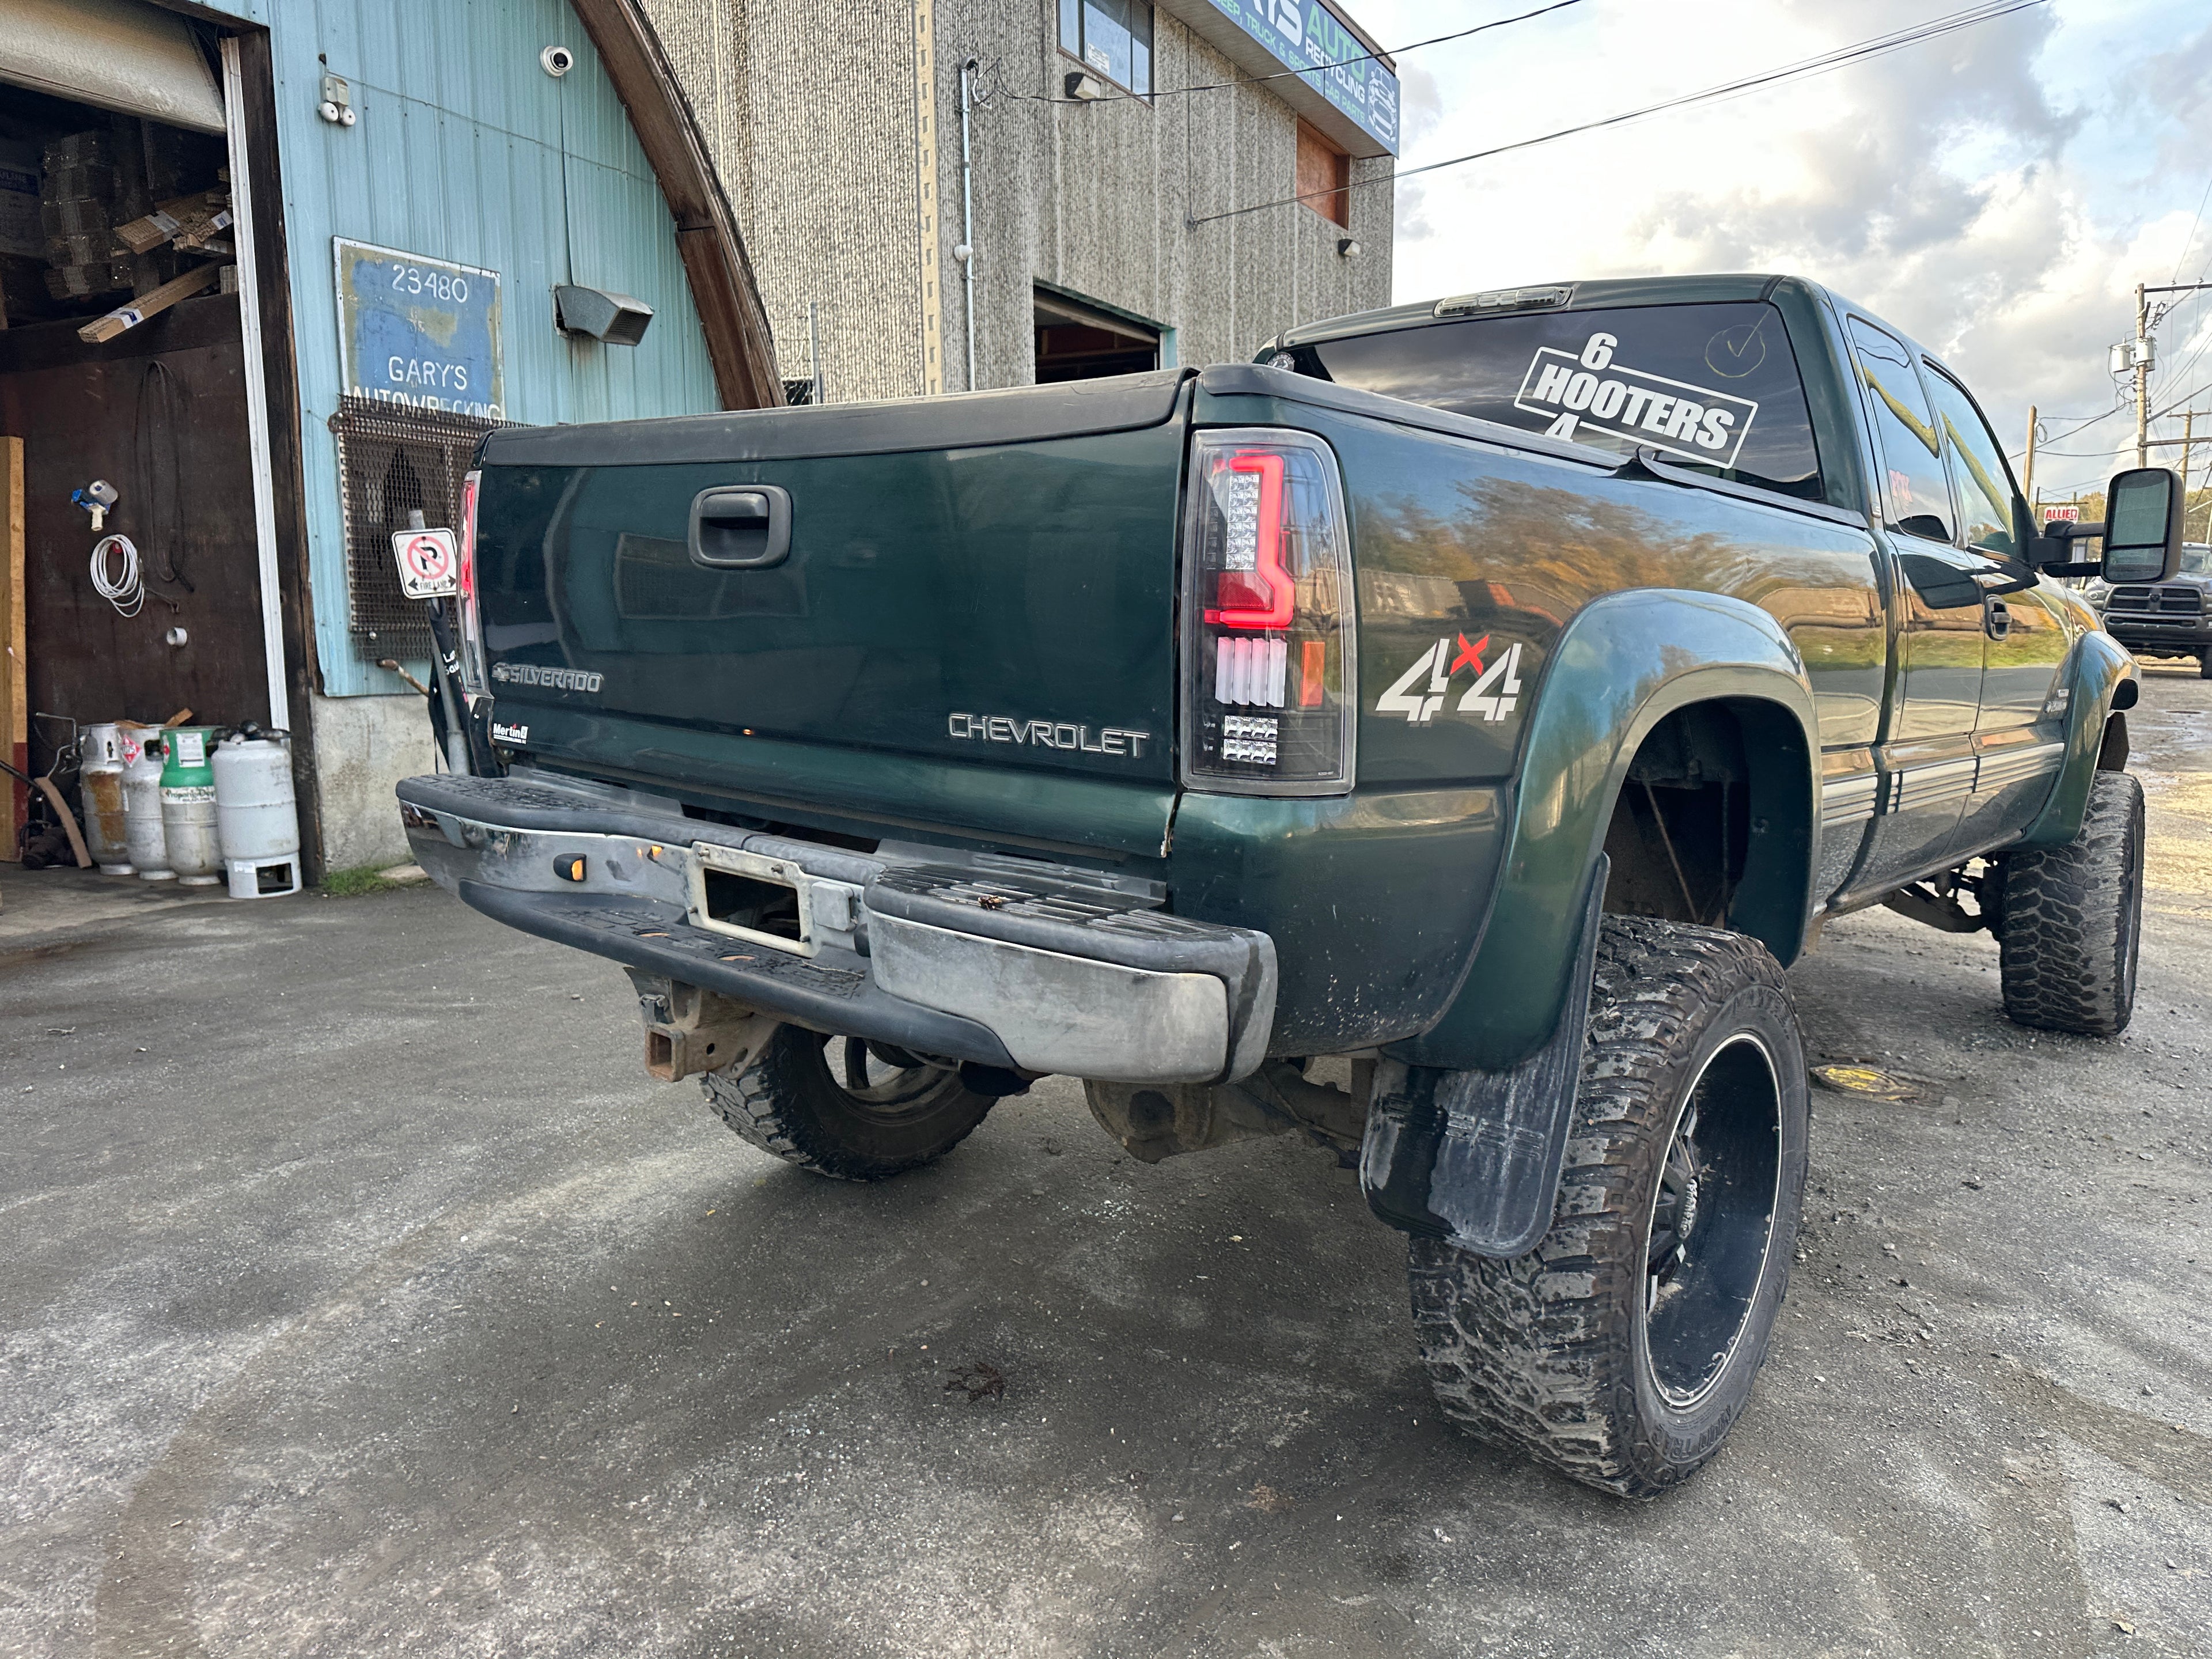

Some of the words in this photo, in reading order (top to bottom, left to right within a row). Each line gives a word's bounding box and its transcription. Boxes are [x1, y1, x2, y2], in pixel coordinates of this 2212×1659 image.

[1306, 4, 1365, 82] AUTO
[1245, 12, 1277, 50] TRUCK
[1279, 41, 1286, 58] &
[1289, 50, 1321, 87] SPORTS
[1325, 80, 1340, 103] CAR
[1342, 95, 1365, 123] PARTS
[1305, 36, 1365, 104] RECYCLING
[392, 264, 468, 303] 23480
[1580, 332, 1618, 370] 6
[388, 356, 468, 391] GARY'S
[1532, 363, 1735, 449] HOOTERS
[2045, 509, 2078, 519] ALLIED
[420, 581, 433, 590] FIRE
[510, 667, 601, 692] SILVERADO
[493, 723, 521, 738] Mertin
[948, 711, 1150, 759] CHEVROLET
